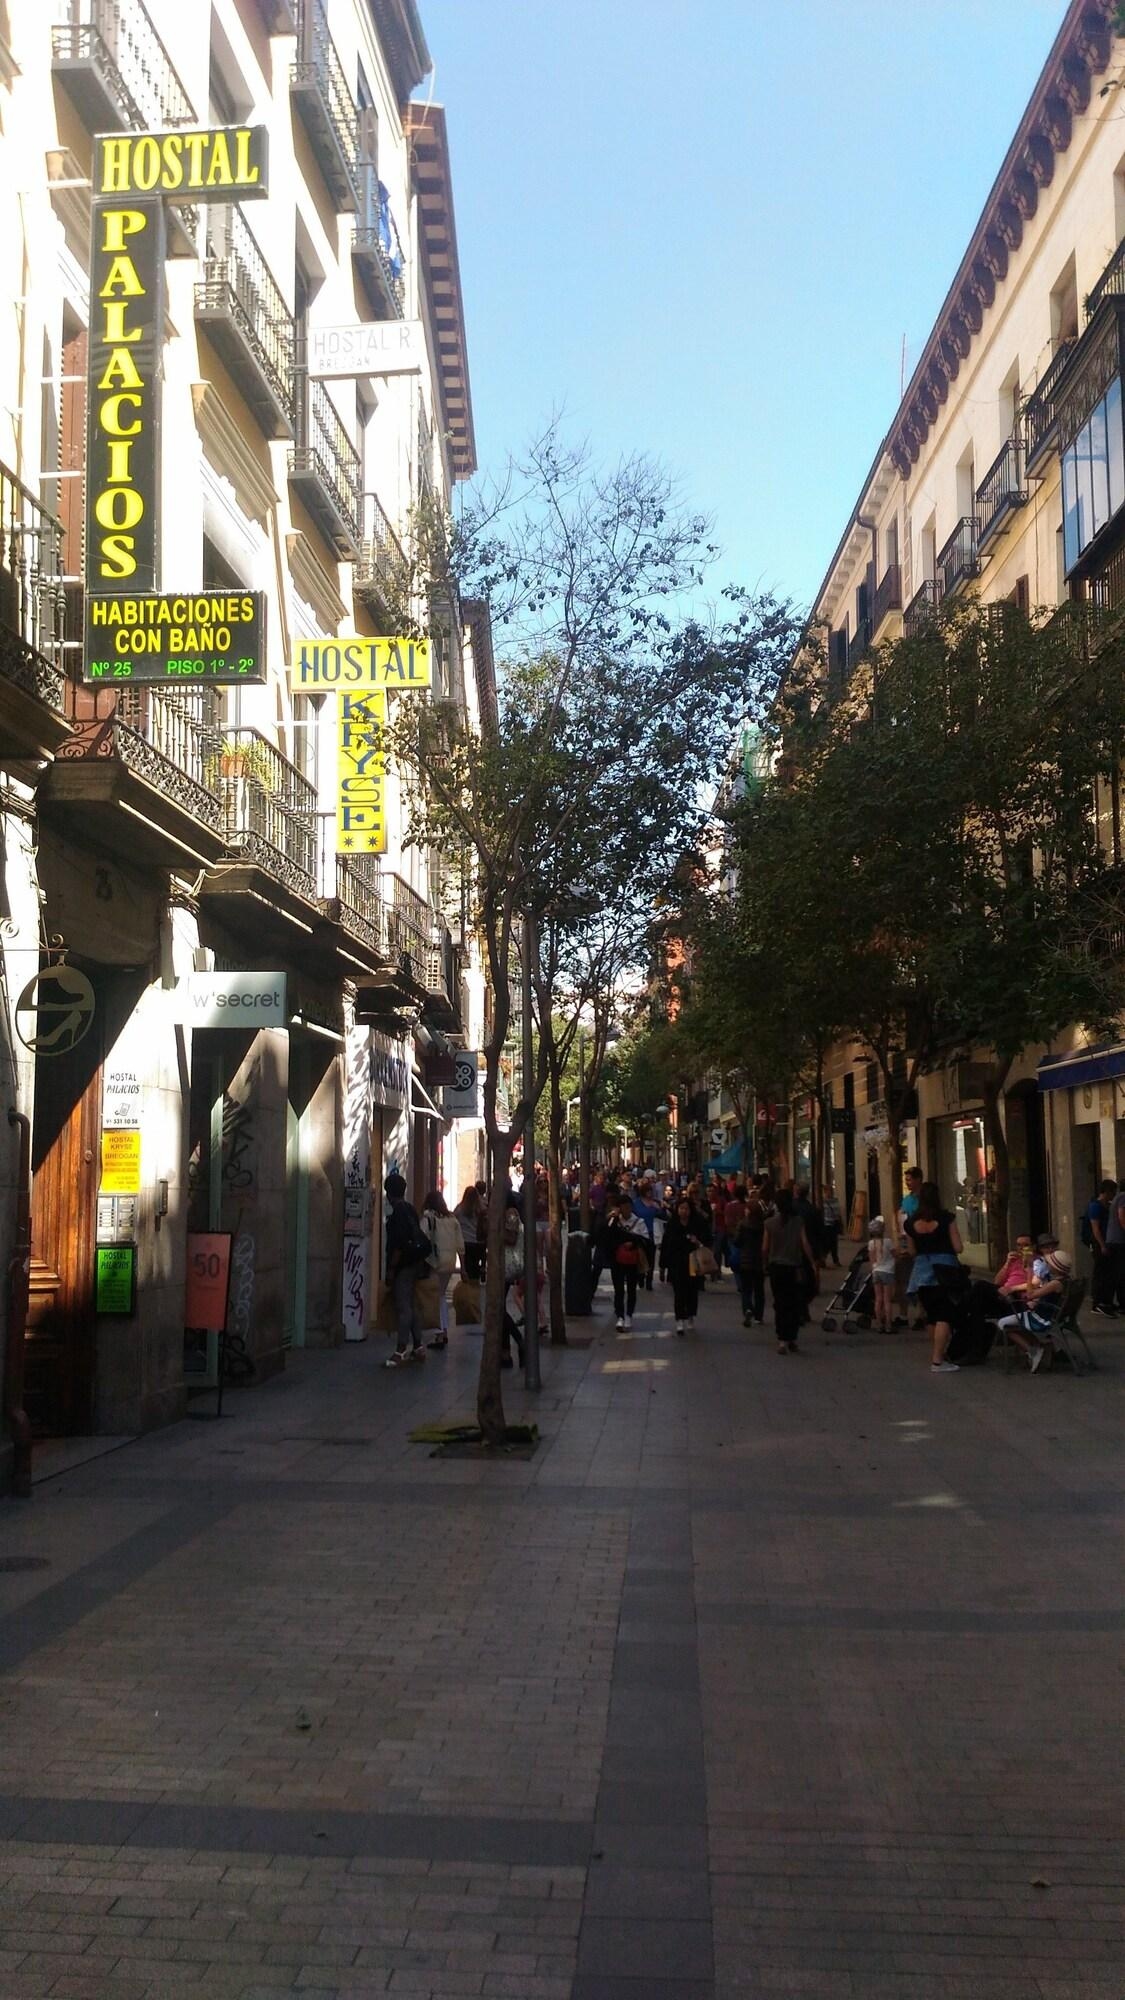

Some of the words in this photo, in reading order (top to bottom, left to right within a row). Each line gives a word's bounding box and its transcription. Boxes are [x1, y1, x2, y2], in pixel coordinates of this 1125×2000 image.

[100, 130, 259, 194] HOSTAL
[314, 327, 391, 355] HOSTAL
[95, 209, 148, 579] PALACIOS
[92, 597, 254, 625] HABITACIONES
[115, 628, 161, 654] CON
[169, 622, 231, 652] BAÑO
[92, 661, 109, 676] Nº
[113, 661, 132, 676] 25
[167, 660, 205, 675] PISO
[210, 659, 224, 674] 1º
[238, 658, 254, 674] 2º
[298, 643, 424, 683] HOSTAL
[341, 692, 381, 832] KRYSE
[106, 1085, 139, 1094] PALACIOS
[110, 1073, 136, 1081] HOSTAL
